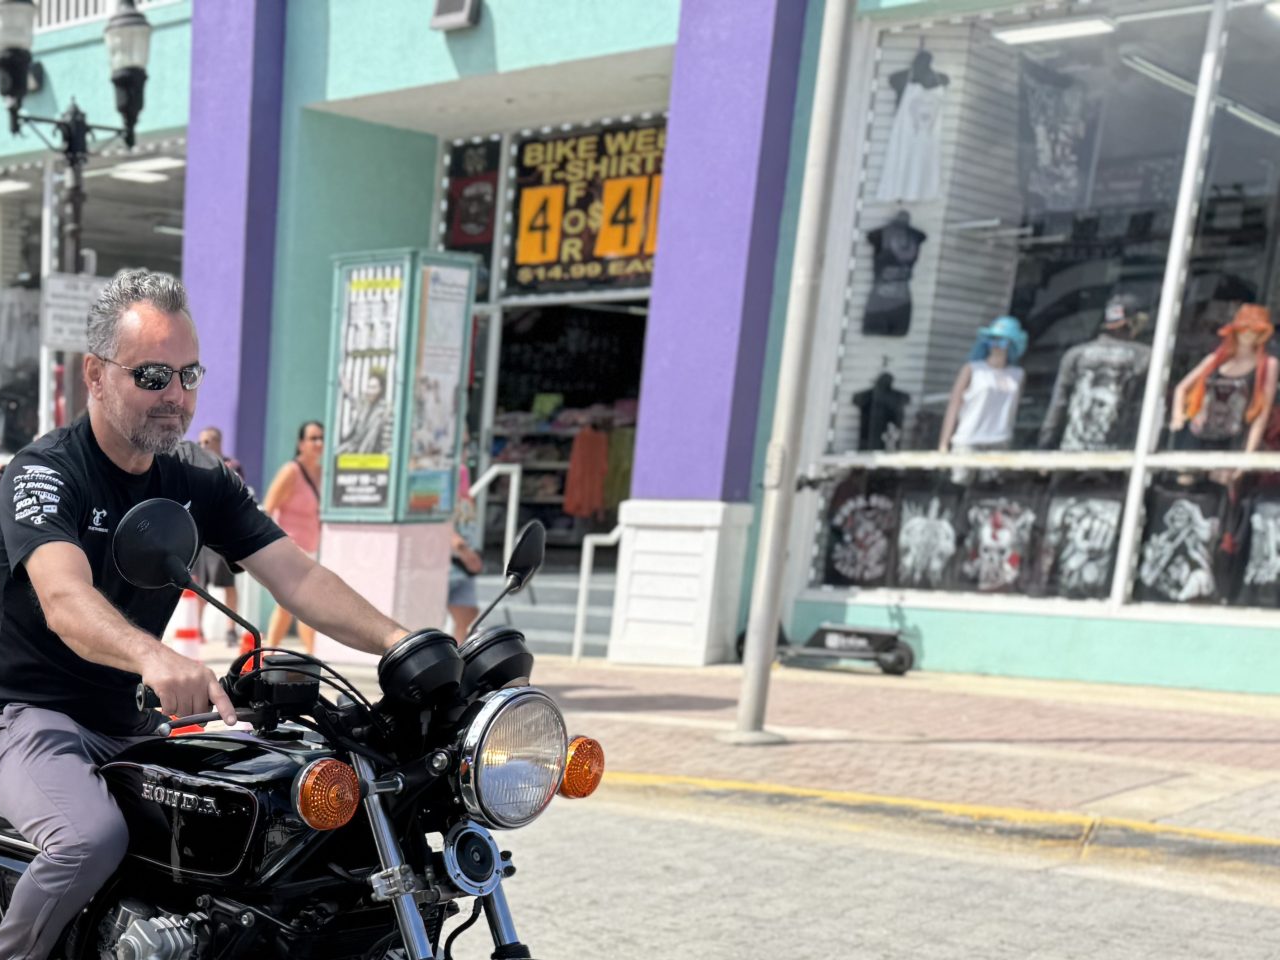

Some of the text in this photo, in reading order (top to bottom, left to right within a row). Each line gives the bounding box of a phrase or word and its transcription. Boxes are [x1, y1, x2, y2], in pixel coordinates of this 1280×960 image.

[523, 128, 667, 168] BIKE WE
[538, 151, 664, 184] T-SHIRT
[528, 196, 550, 254] 4
[608, 258, 654, 275] EAC
[141, 783, 221, 816] HONDA
